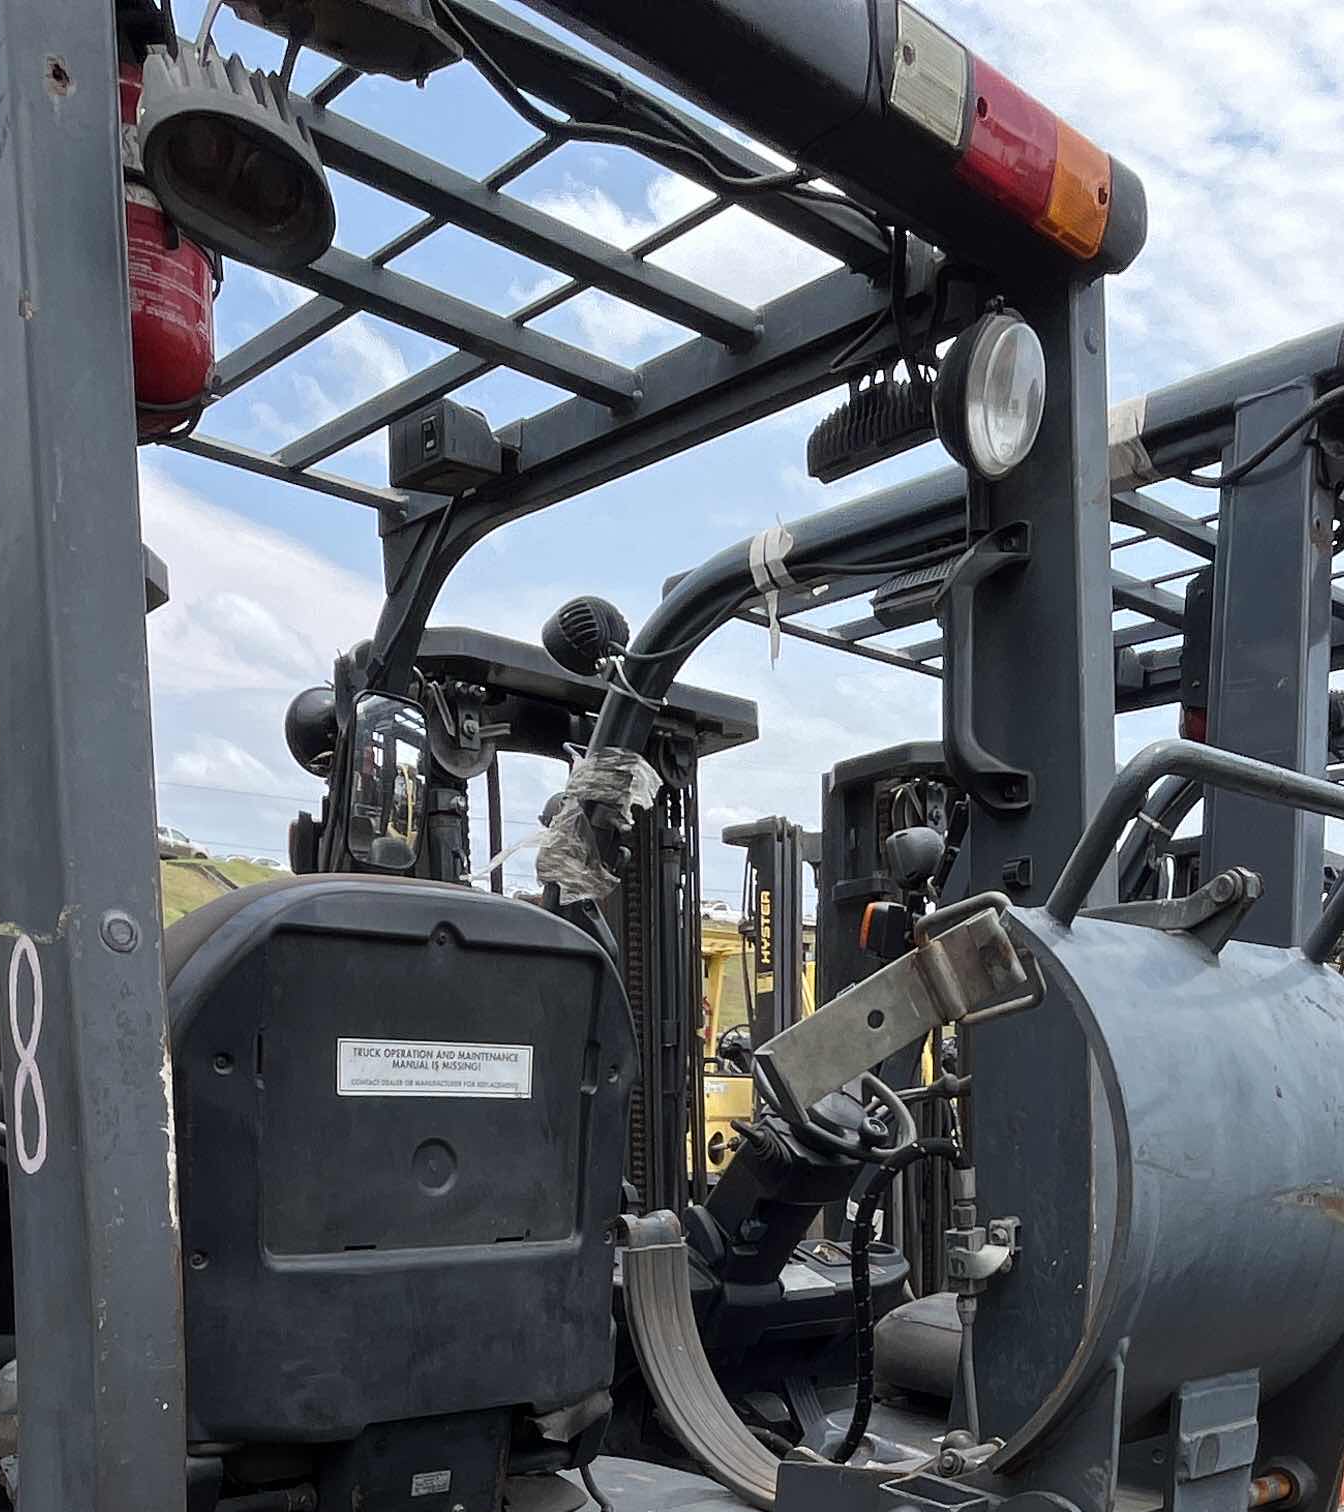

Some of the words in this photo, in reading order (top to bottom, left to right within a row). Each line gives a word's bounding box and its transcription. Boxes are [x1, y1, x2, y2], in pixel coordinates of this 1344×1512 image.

[8, 933, 47, 1174] 8
[353, 1047, 381, 1058] TRUCK
[383, 1048, 433, 1060] OPERATION
[436, 1050, 456, 1060] AND
[458, 1051, 519, 1063] MAINTENANCE
[392, 1059, 429, 1071] MANUAL
[431, 1060, 440, 1072] IS
[442, 1061, 482, 1072] MISSING!
